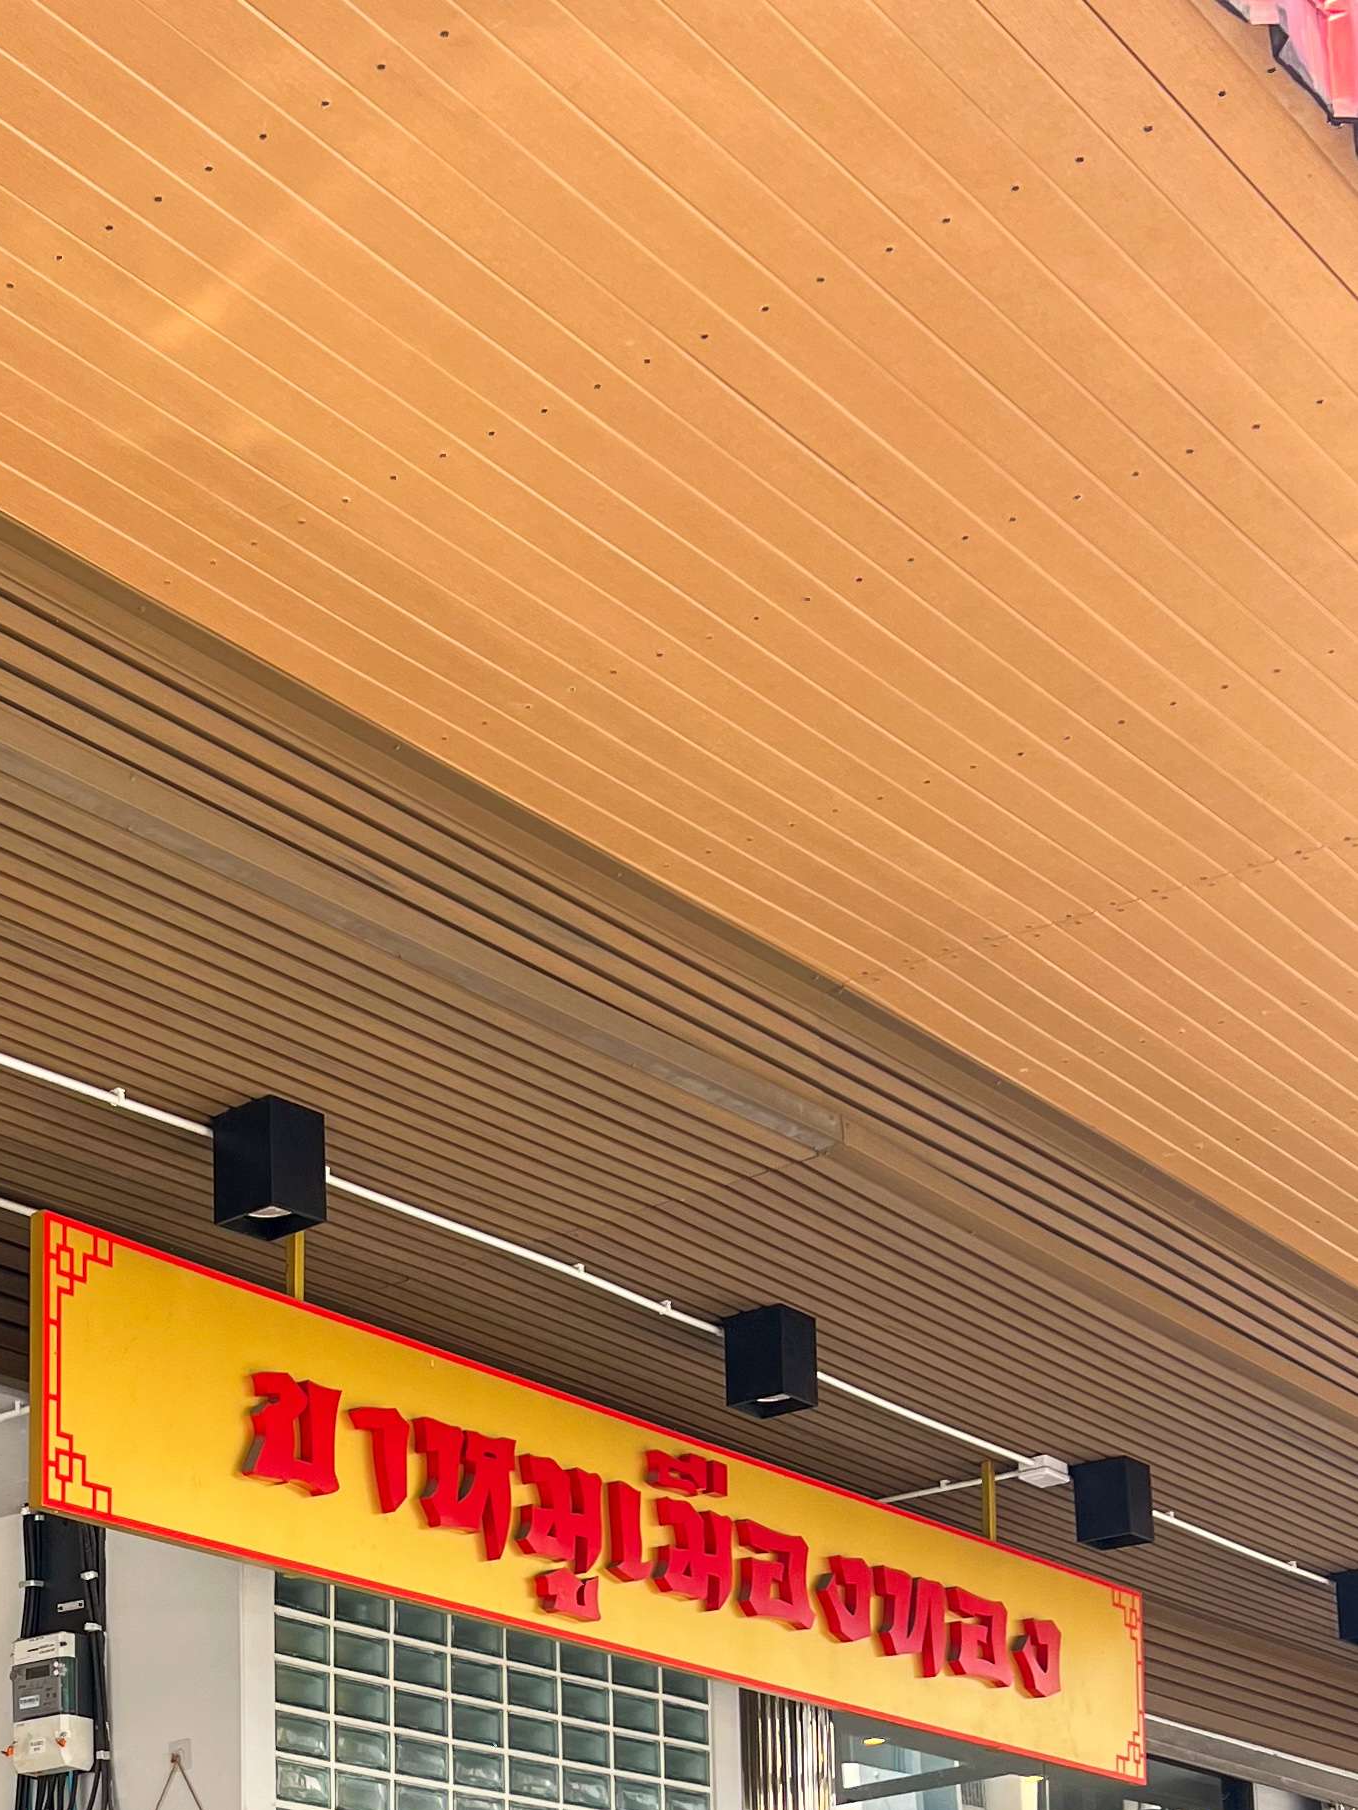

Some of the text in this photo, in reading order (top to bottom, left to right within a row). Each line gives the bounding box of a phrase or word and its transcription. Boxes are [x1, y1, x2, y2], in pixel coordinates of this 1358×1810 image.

[241, 1370, 1064, 1699] ขาหมูเมืองทอง
